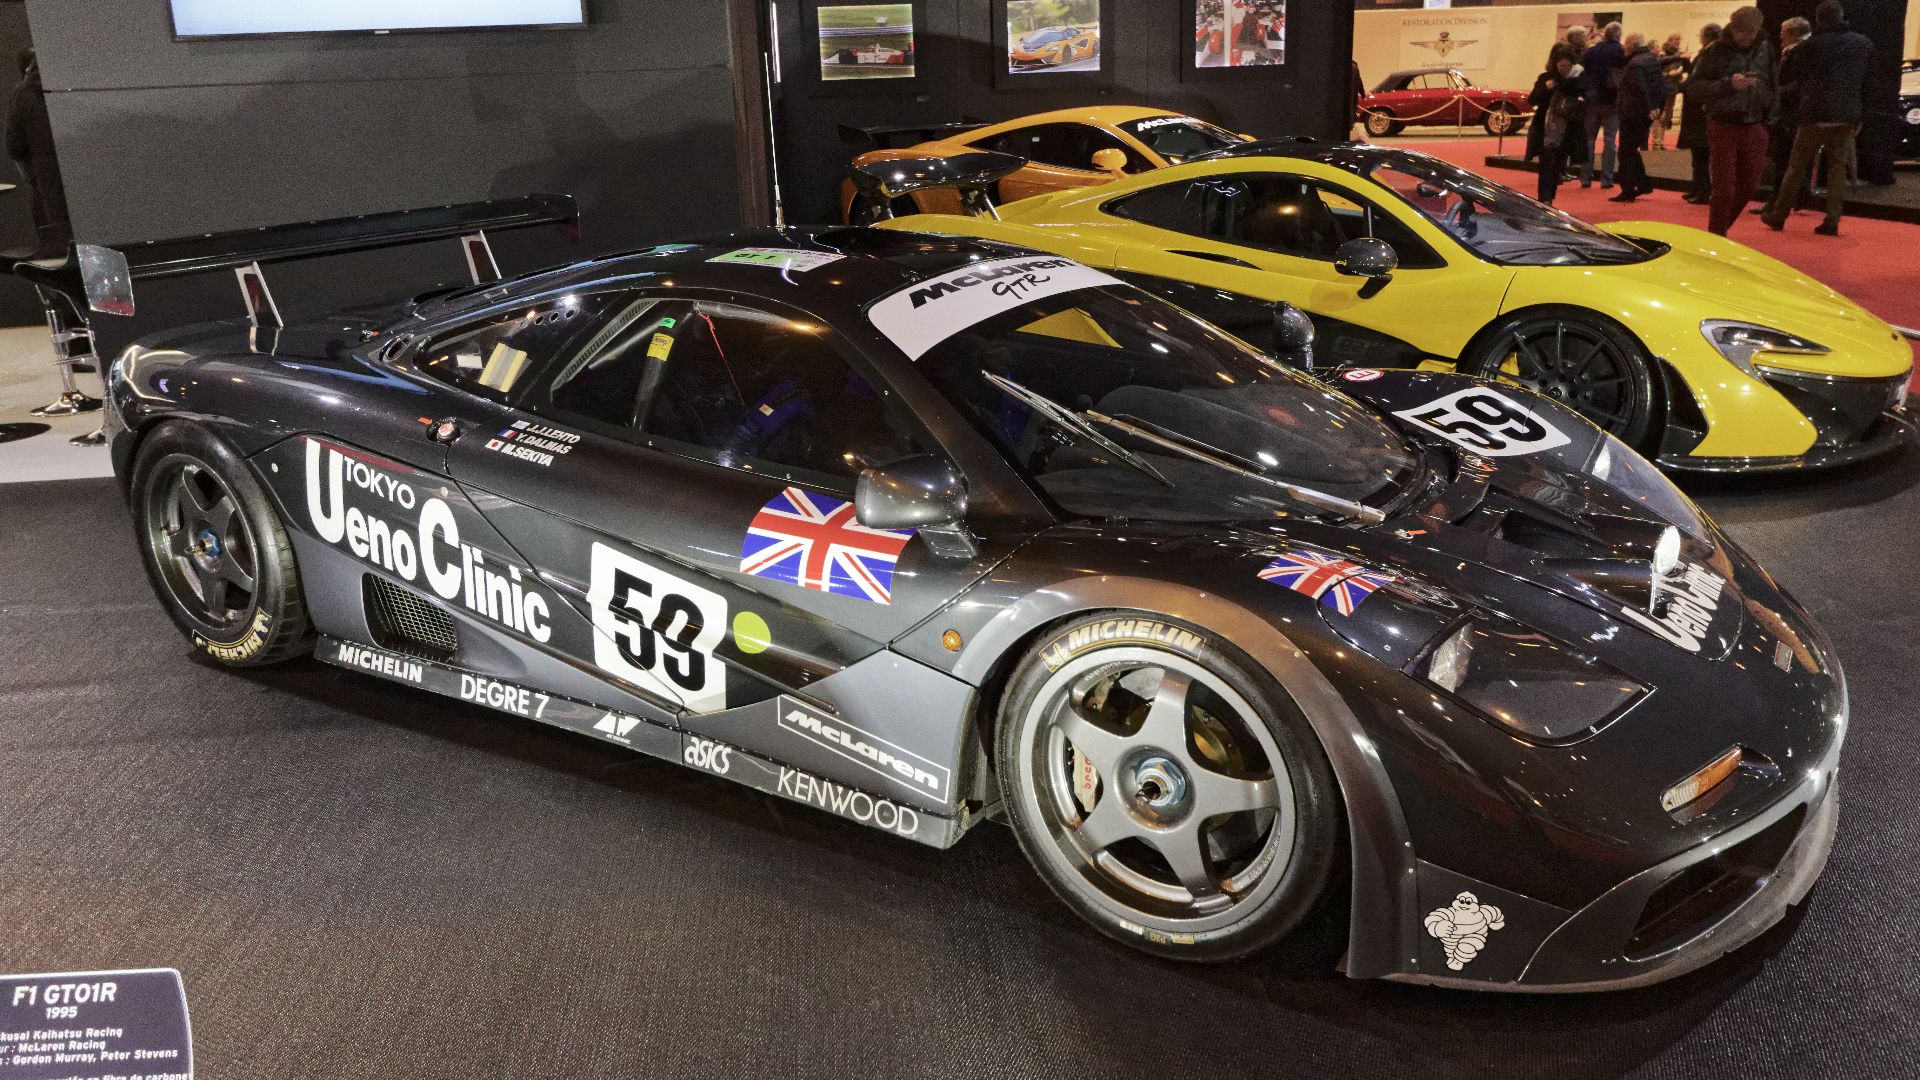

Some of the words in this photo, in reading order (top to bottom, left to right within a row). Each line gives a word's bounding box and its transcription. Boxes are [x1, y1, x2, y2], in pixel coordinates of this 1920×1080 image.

[908, 257, 1077, 309] McLaren
[991, 273, 1050, 299] GTR
[1411, 394, 1547, 450] 59
[344, 457, 416, 510] TOKYO
[305, 437, 417, 581] Ueno
[418, 498, 551, 643] Clinic
[608, 567, 706, 692] 59
[1068, 619, 1202, 652] MICHELIN
[338, 644, 423, 683] MICHELIN
[460, 674, 530, 716] DEGRE
[527, 692, 550, 719] 7
[684, 736, 732, 775] asics
[785, 710, 939, 790] McLaren
[777, 766, 919, 836] KENWOOD
[13, 985, 37, 1006] F1
[46, 1006, 78, 1019] 1995
[18, 1042, 65, 1053] McLaren
[69, 1040, 106, 1050] Racing
[86, 1028, 123, 1038] Racing
[13, 1054, 52, 1065] Gordon
[55, 1053, 97, 1063] Murray,
[101, 1051, 130, 1061] Peter
[134, 1049, 178, 1059] Stevens
